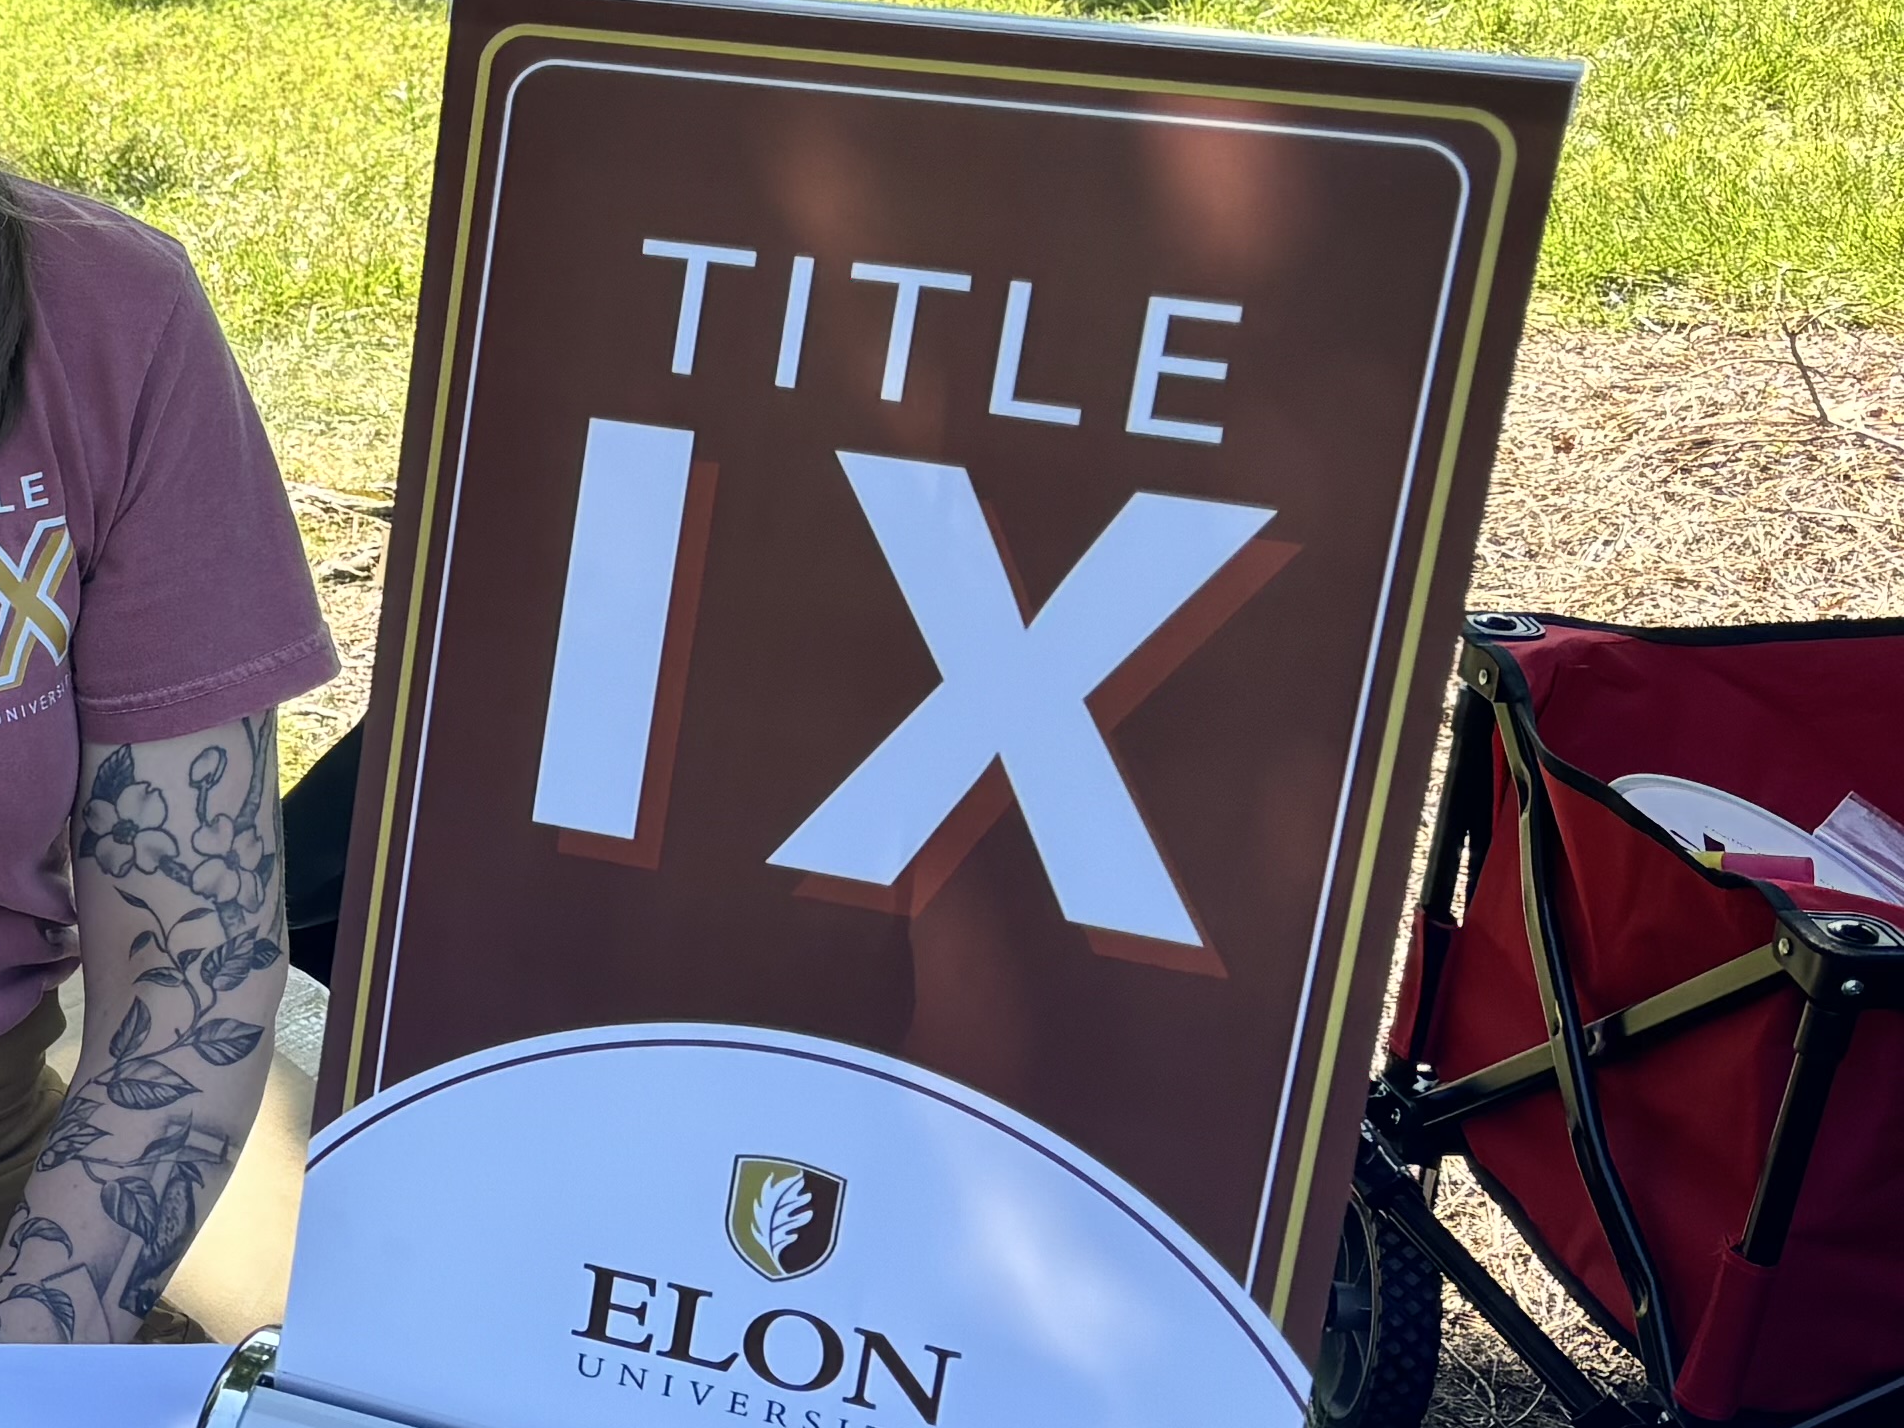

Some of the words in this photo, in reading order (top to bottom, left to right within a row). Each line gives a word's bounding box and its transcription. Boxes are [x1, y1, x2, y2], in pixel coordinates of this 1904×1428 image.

[641, 236, 1244, 446] TITLE
[530, 415, 1292, 964] IX
[571, 1263, 961, 1427] ELON
